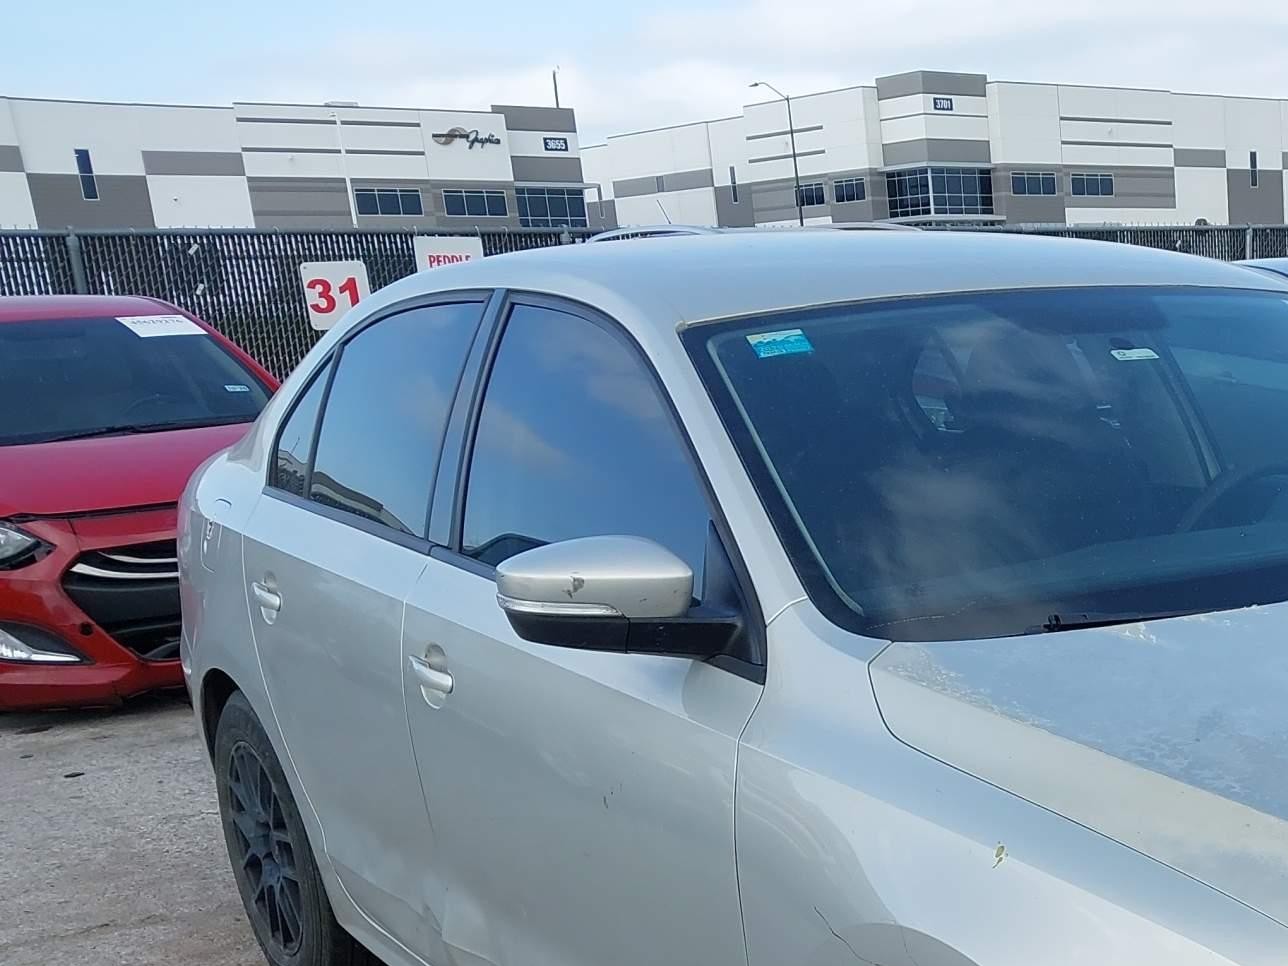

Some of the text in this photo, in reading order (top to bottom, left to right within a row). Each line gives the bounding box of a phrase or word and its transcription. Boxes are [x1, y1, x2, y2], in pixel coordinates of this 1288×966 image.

[935, 99, 951, 110] 3701
[545, 139, 566, 150] 3655
[306, 276, 360, 314] 31
